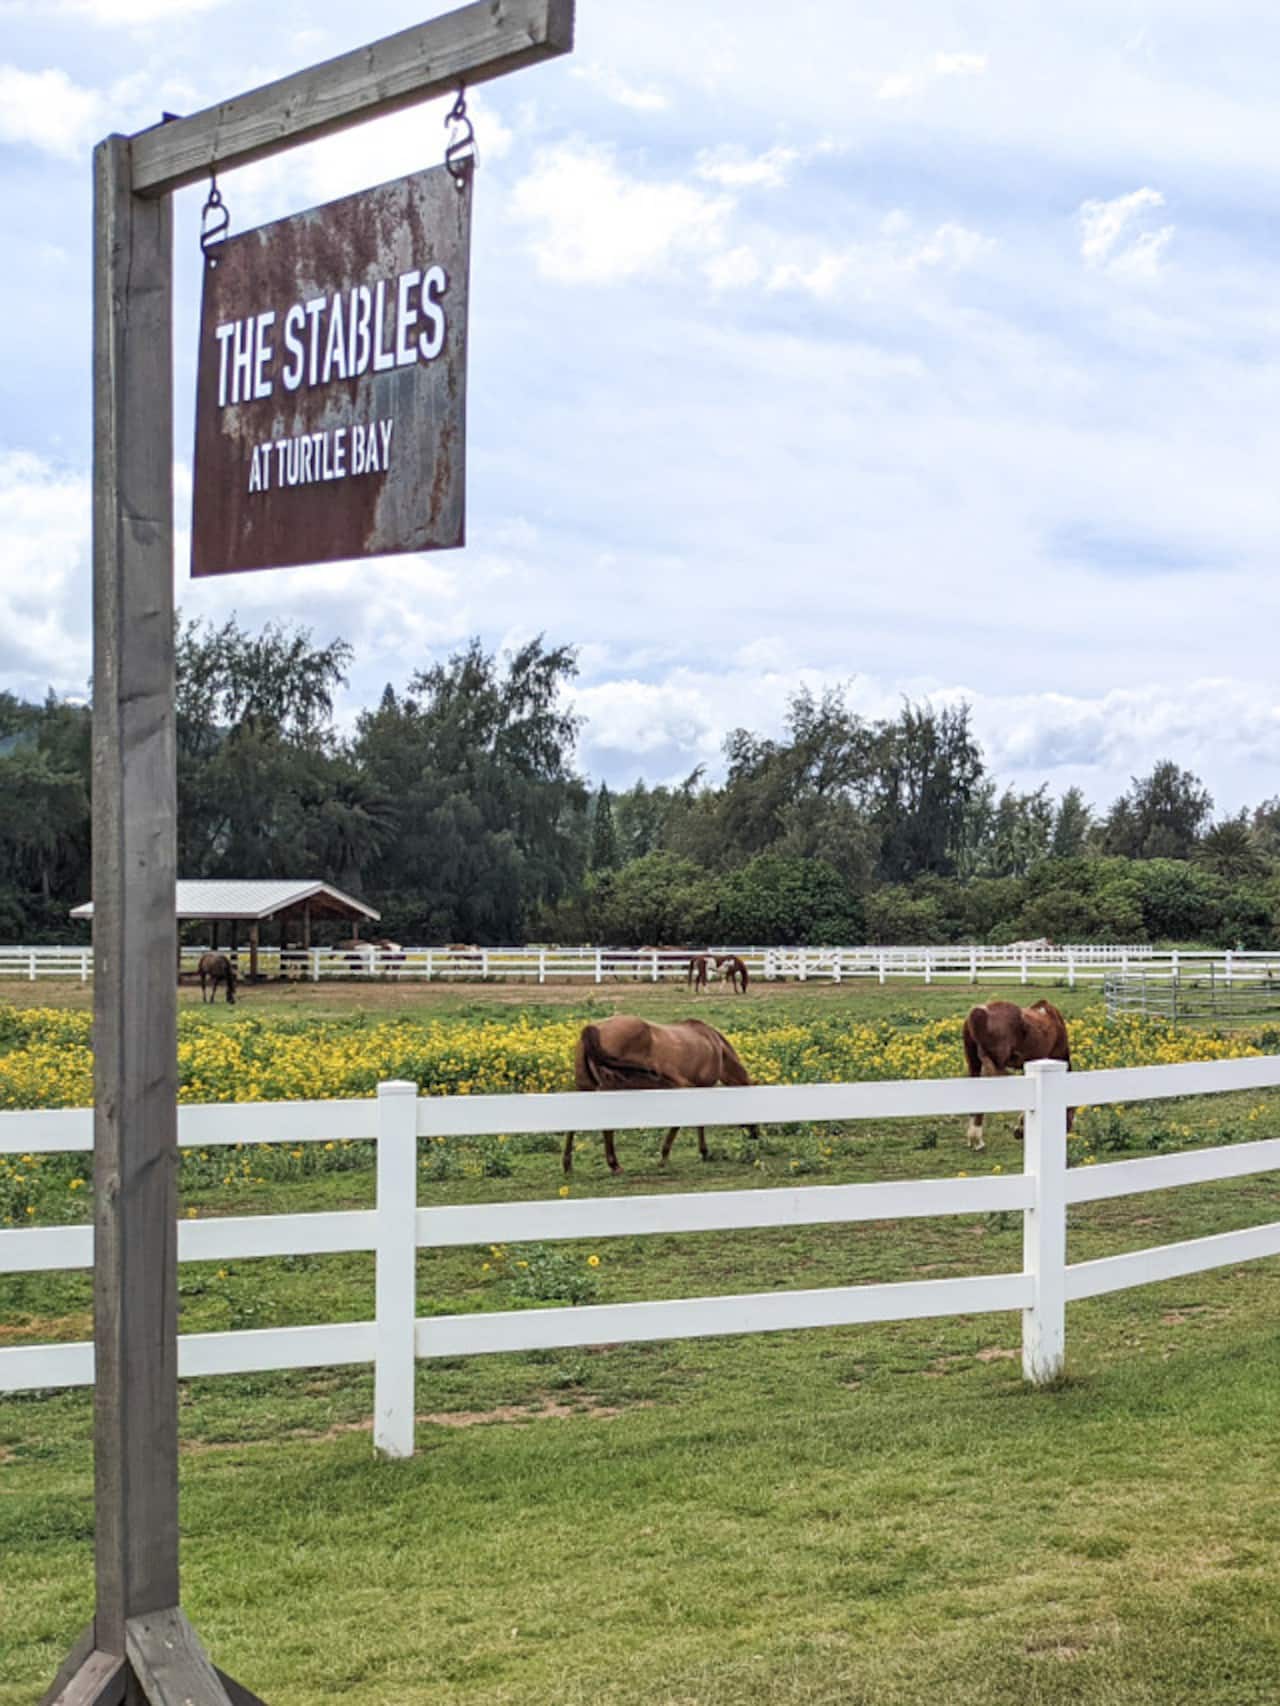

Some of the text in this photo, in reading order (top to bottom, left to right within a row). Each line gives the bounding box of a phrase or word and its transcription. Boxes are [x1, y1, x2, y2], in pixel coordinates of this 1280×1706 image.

[216, 265, 447, 407] THE STABLES
[248, 419, 393, 493] AT TURTLE BAY
